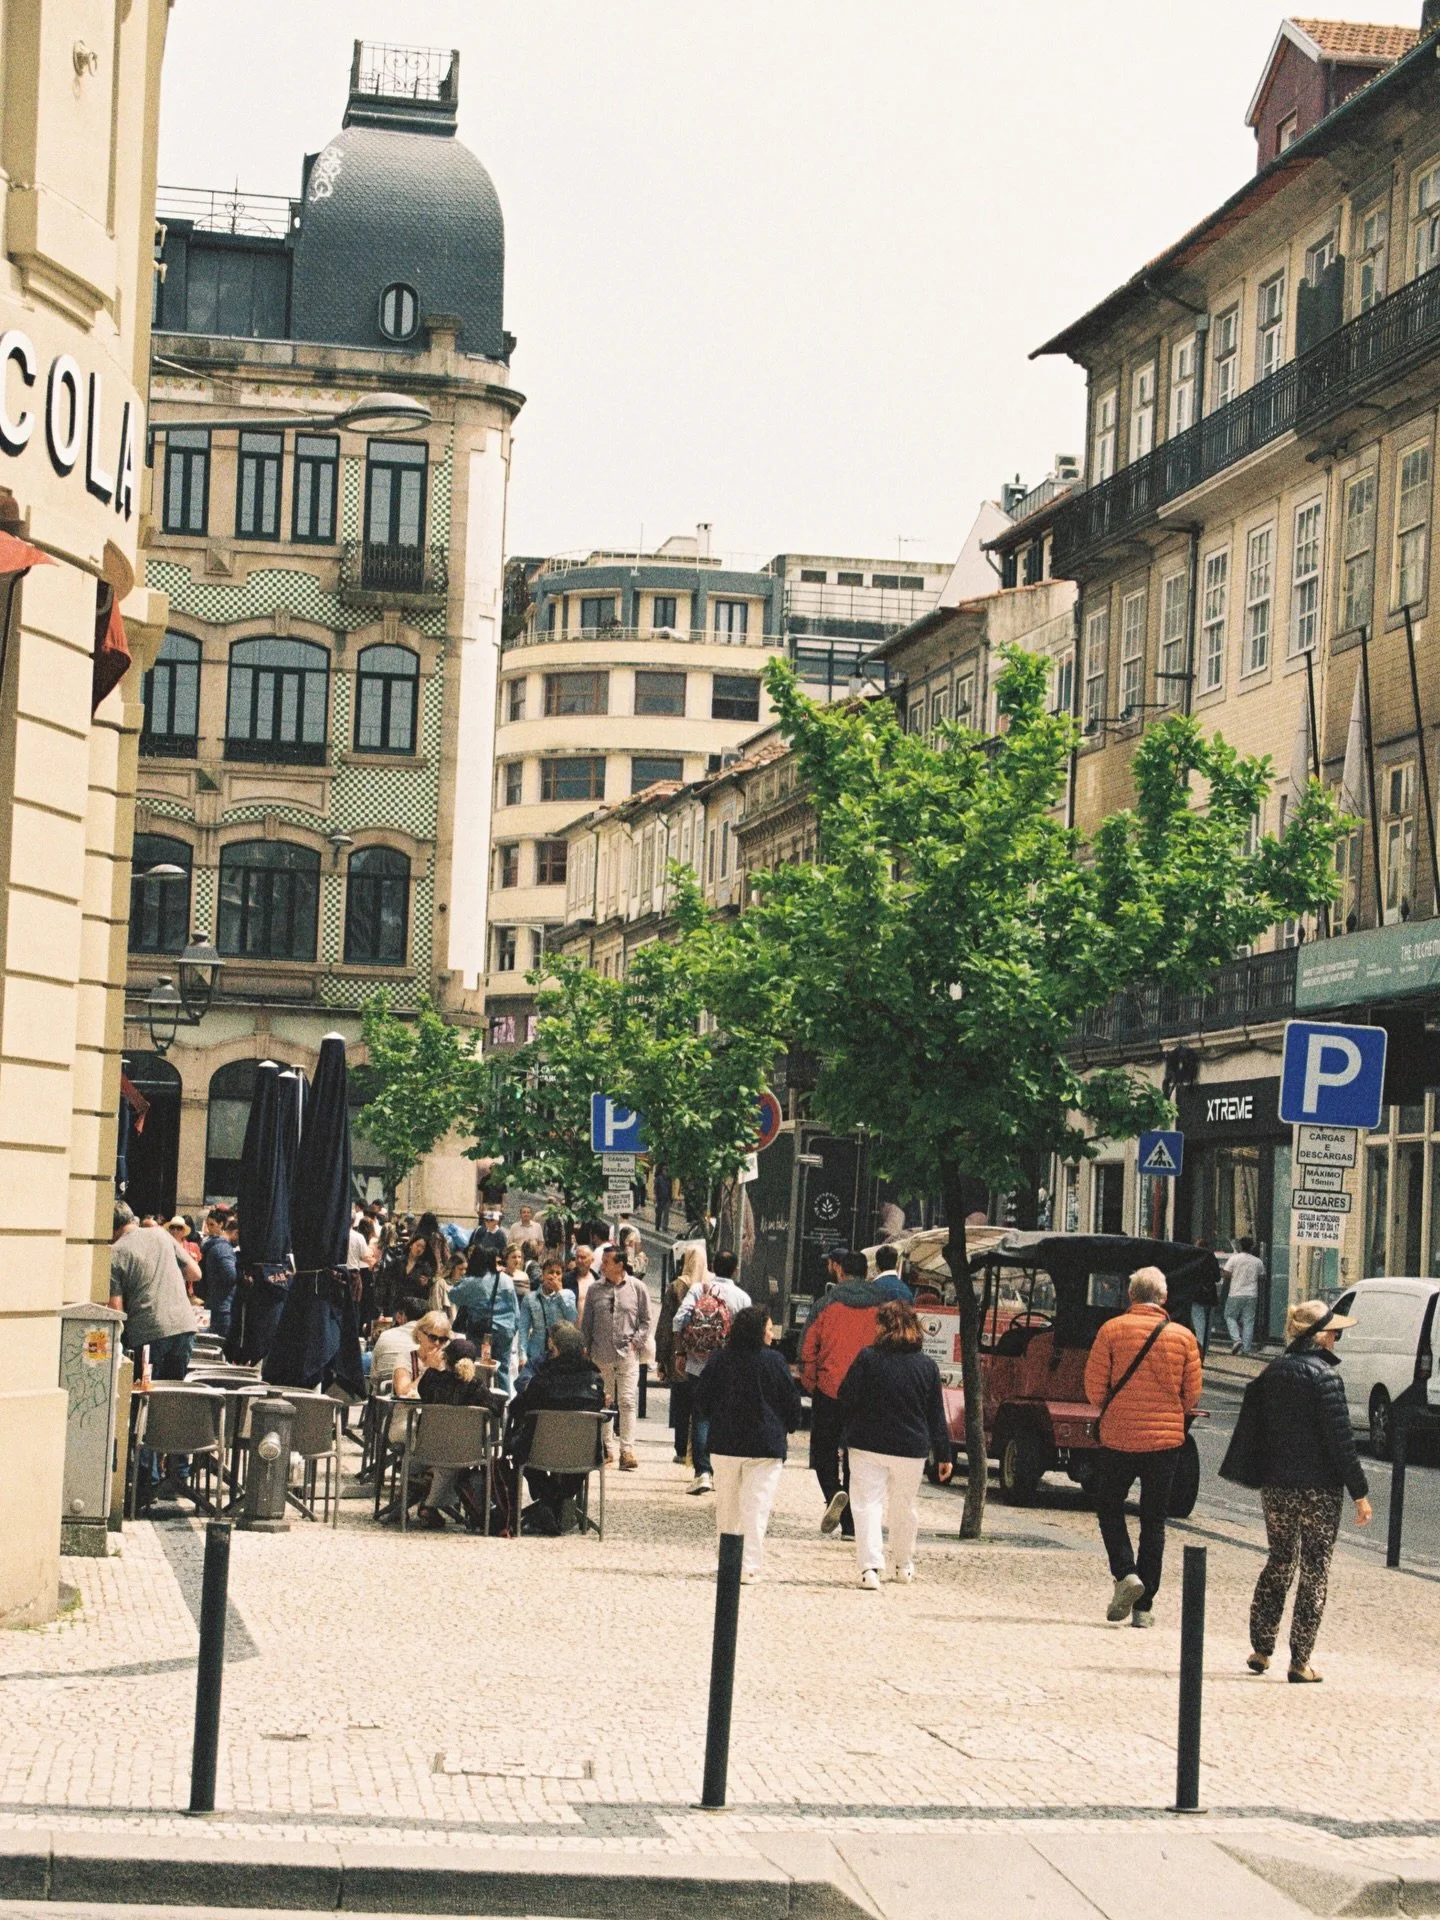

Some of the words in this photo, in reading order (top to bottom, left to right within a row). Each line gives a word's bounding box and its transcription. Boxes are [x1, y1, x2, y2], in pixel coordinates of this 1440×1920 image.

[0, 330, 136, 523] COLA
[1302, 1033, 1362, 1113] P
[1207, 1096, 1253, 1122] XTREME
[605, 1099, 637, 1146] P
[1309, 1132, 1346, 1142] CARGAS
[1324, 1143, 1331, 1152] E
[1299, 1150, 1353, 1161] DESCARGAS
[1306, 1168, 1341, 1179] MÁXIMO
[1311, 1178, 1335, 1187] 15min
[1297, 1194, 1346, 1208] 2LUGARES
[1297, 1220, 1306, 1230] DAS
[1313, 1231, 1320, 1239] DE
